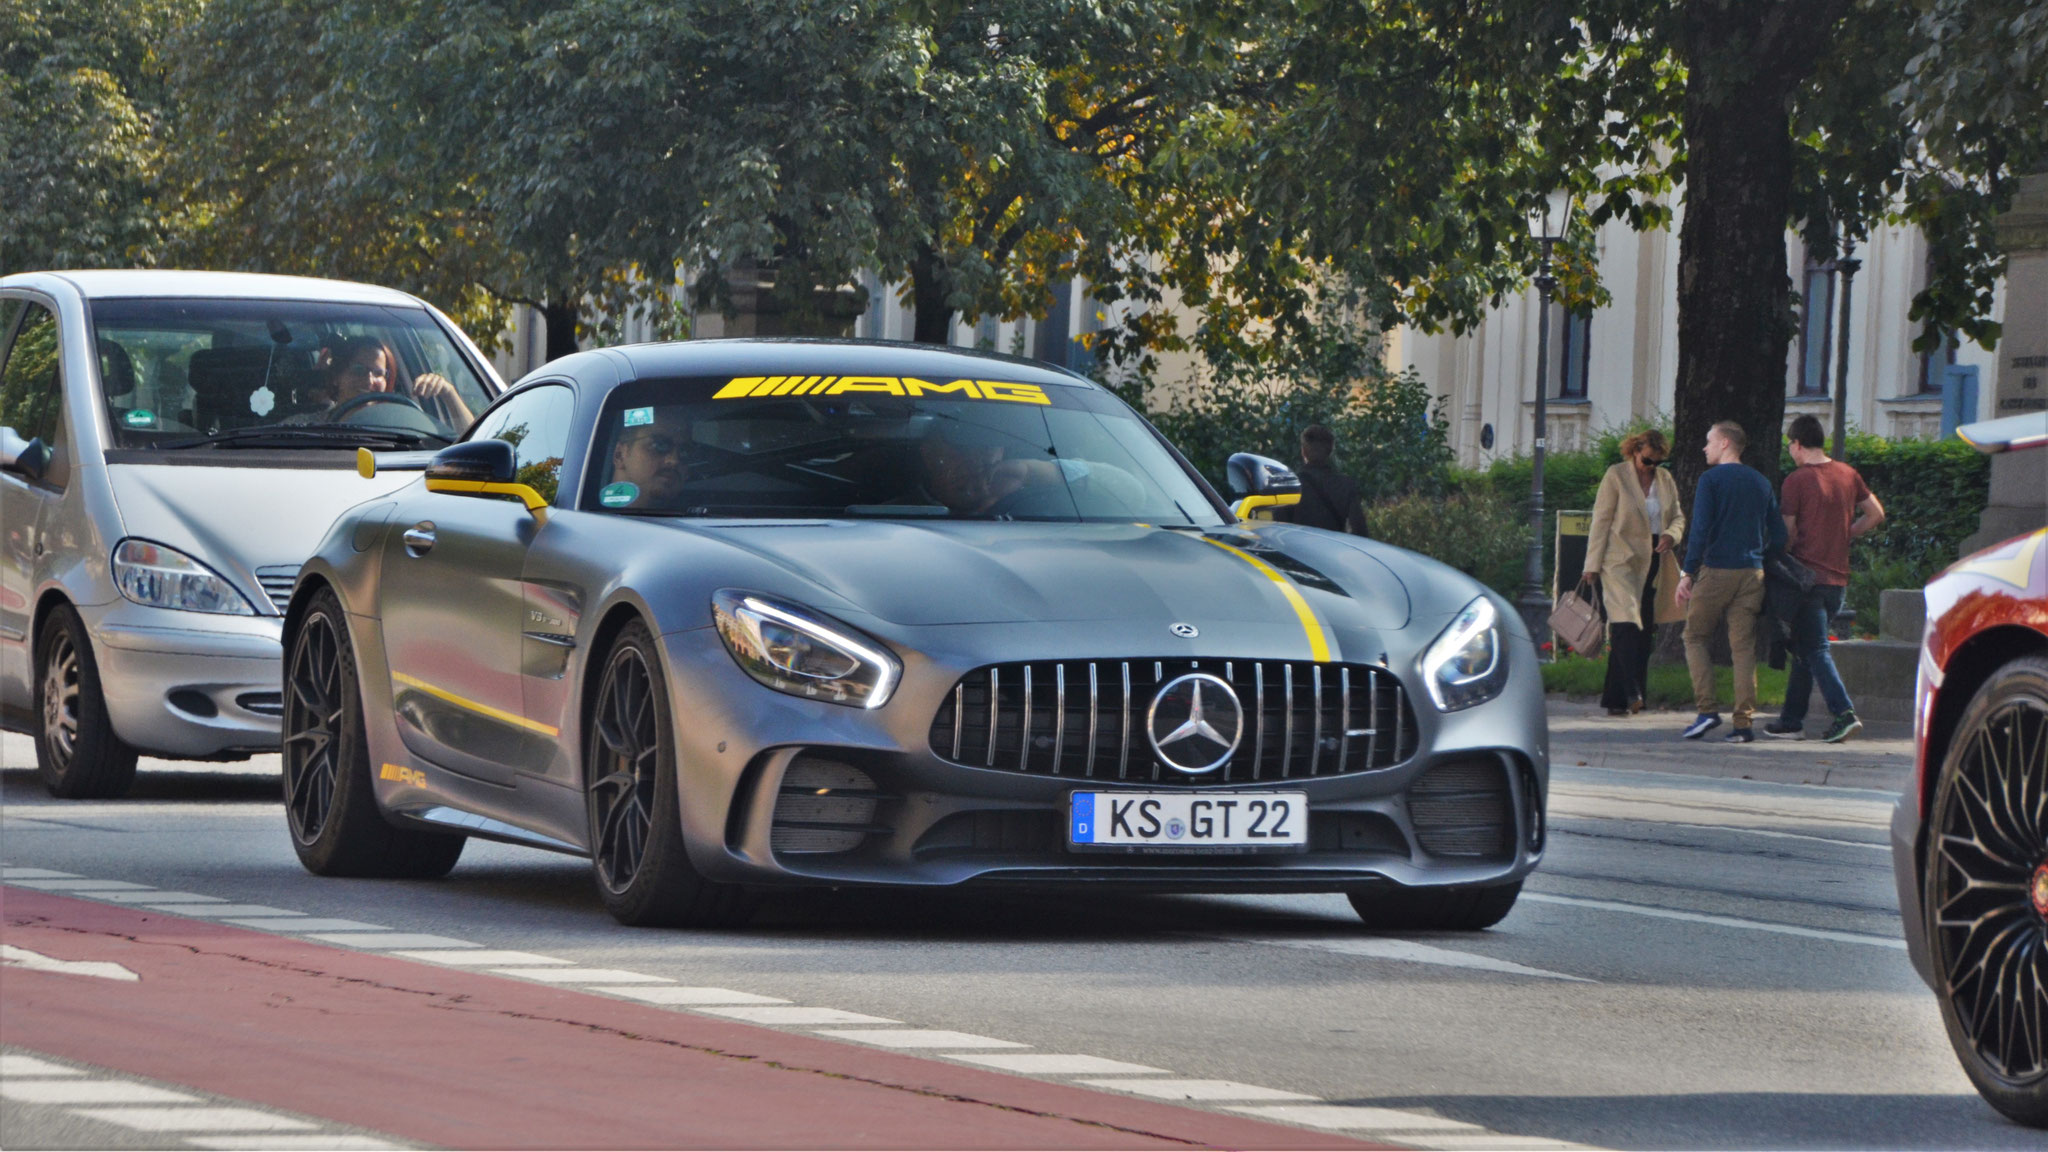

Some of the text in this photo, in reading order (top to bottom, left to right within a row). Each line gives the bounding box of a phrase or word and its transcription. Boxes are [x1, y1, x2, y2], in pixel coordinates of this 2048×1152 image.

[825, 376, 1052, 405] AMG
[1078, 823, 1088, 834] D
[1110, 799, 1291, 838] KS GT 22
